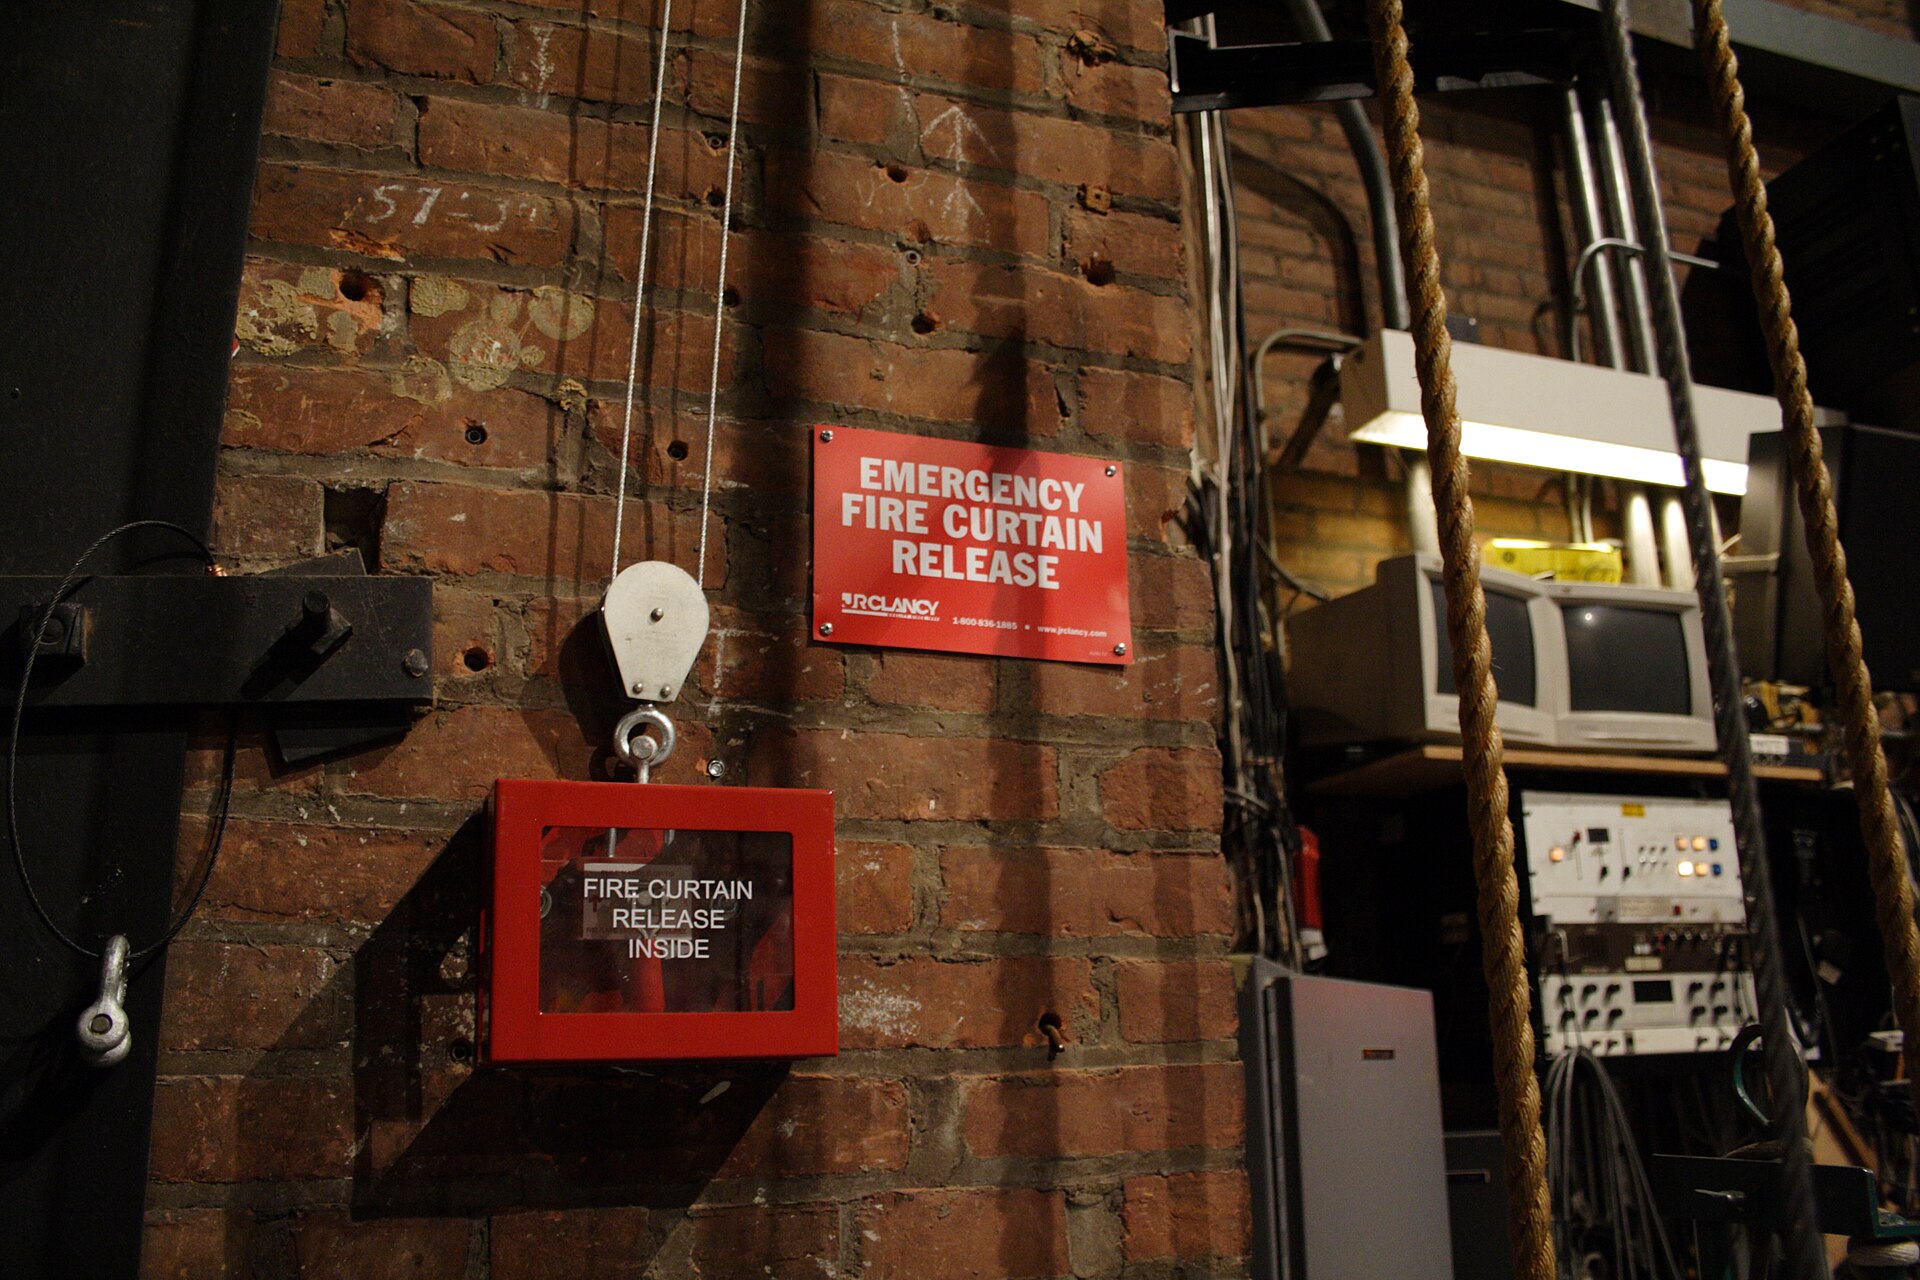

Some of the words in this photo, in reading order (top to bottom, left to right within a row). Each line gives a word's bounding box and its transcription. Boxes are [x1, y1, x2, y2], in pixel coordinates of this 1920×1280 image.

[860, 457, 1085, 514] EMERGENCY
[842, 492, 929, 535] FIRE
[943, 504, 1103, 553] CURTAIN
[893, 539, 1060, 590] RELEASE
[584, 878, 640, 899] FIRE
[648, 879, 753, 900] CURTAIN
[612, 909, 726, 929] RELEASE
[628, 938, 710, 959] INSIDE
